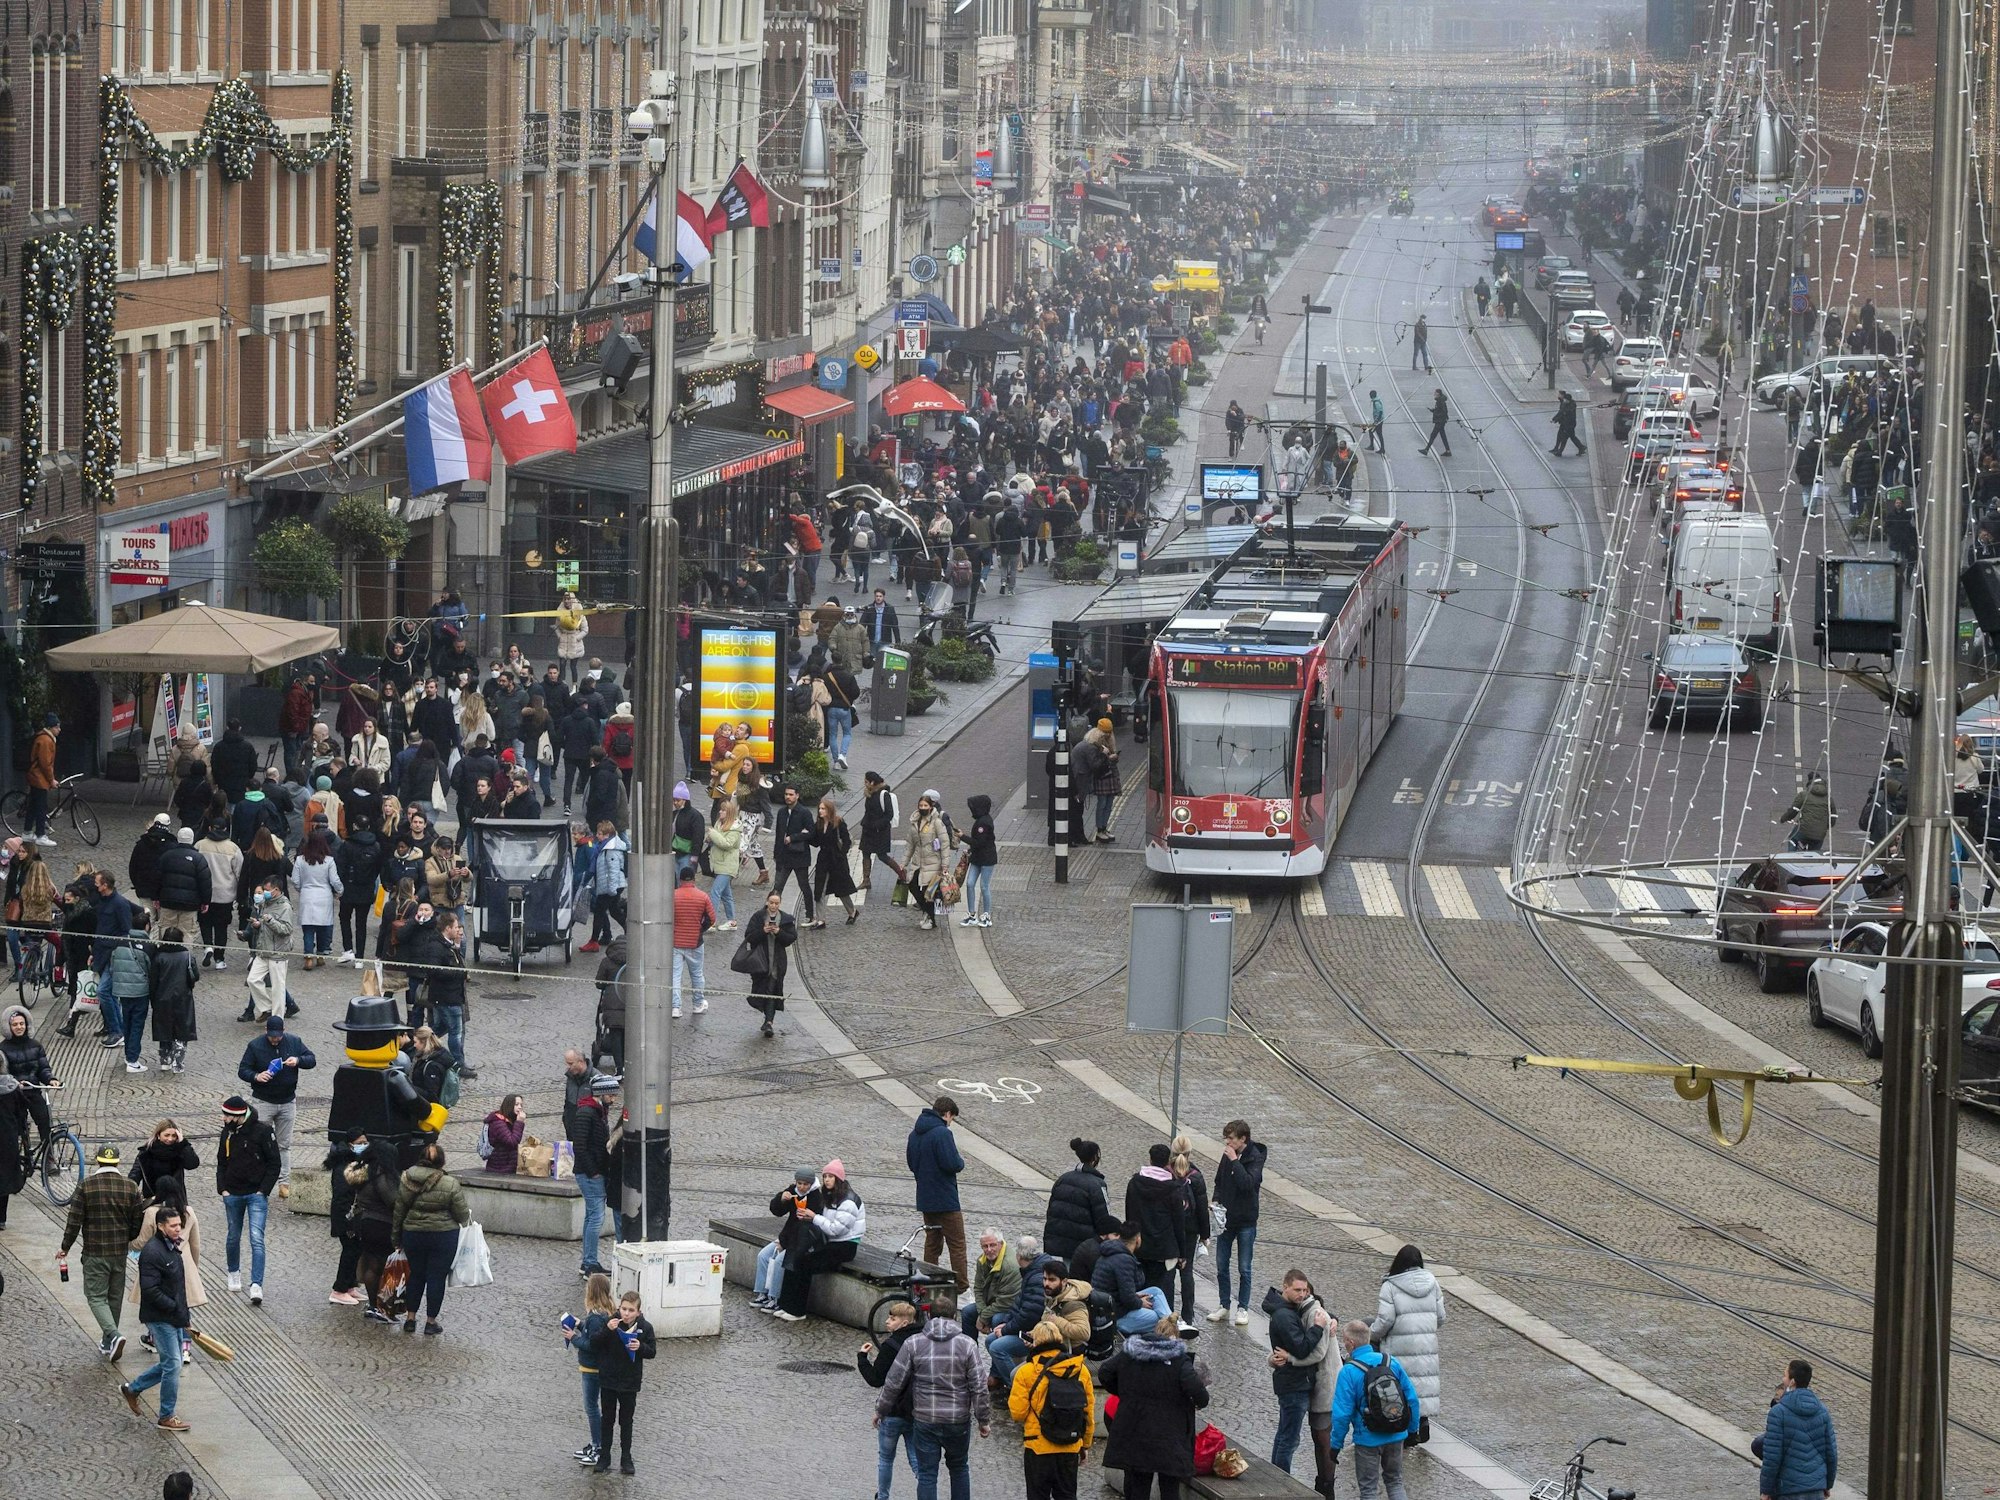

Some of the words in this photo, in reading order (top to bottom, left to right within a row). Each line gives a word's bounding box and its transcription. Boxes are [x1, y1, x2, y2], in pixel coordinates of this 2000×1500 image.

[912, 401, 944, 409] KFC
[169, 511, 209, 551] TICKETS
[122, 537, 156, 549] TOURS
[38, 547, 81, 556] Restaurant
[133, 549, 142, 559] &
[38, 558, 67, 569] Bakery
[118, 559, 160, 570] TICKETS
[146, 576, 163, 585] ATM
[707, 634, 731, 645] THE
[731, 634, 772, 646] LIGHTS
[706, 646, 731, 656] ARE
[731, 647, 750, 656] ON
[1181, 659, 1190, 676] 4
[1214, 660, 1261, 675] Station
[1392, 791, 1514, 808] BUS
